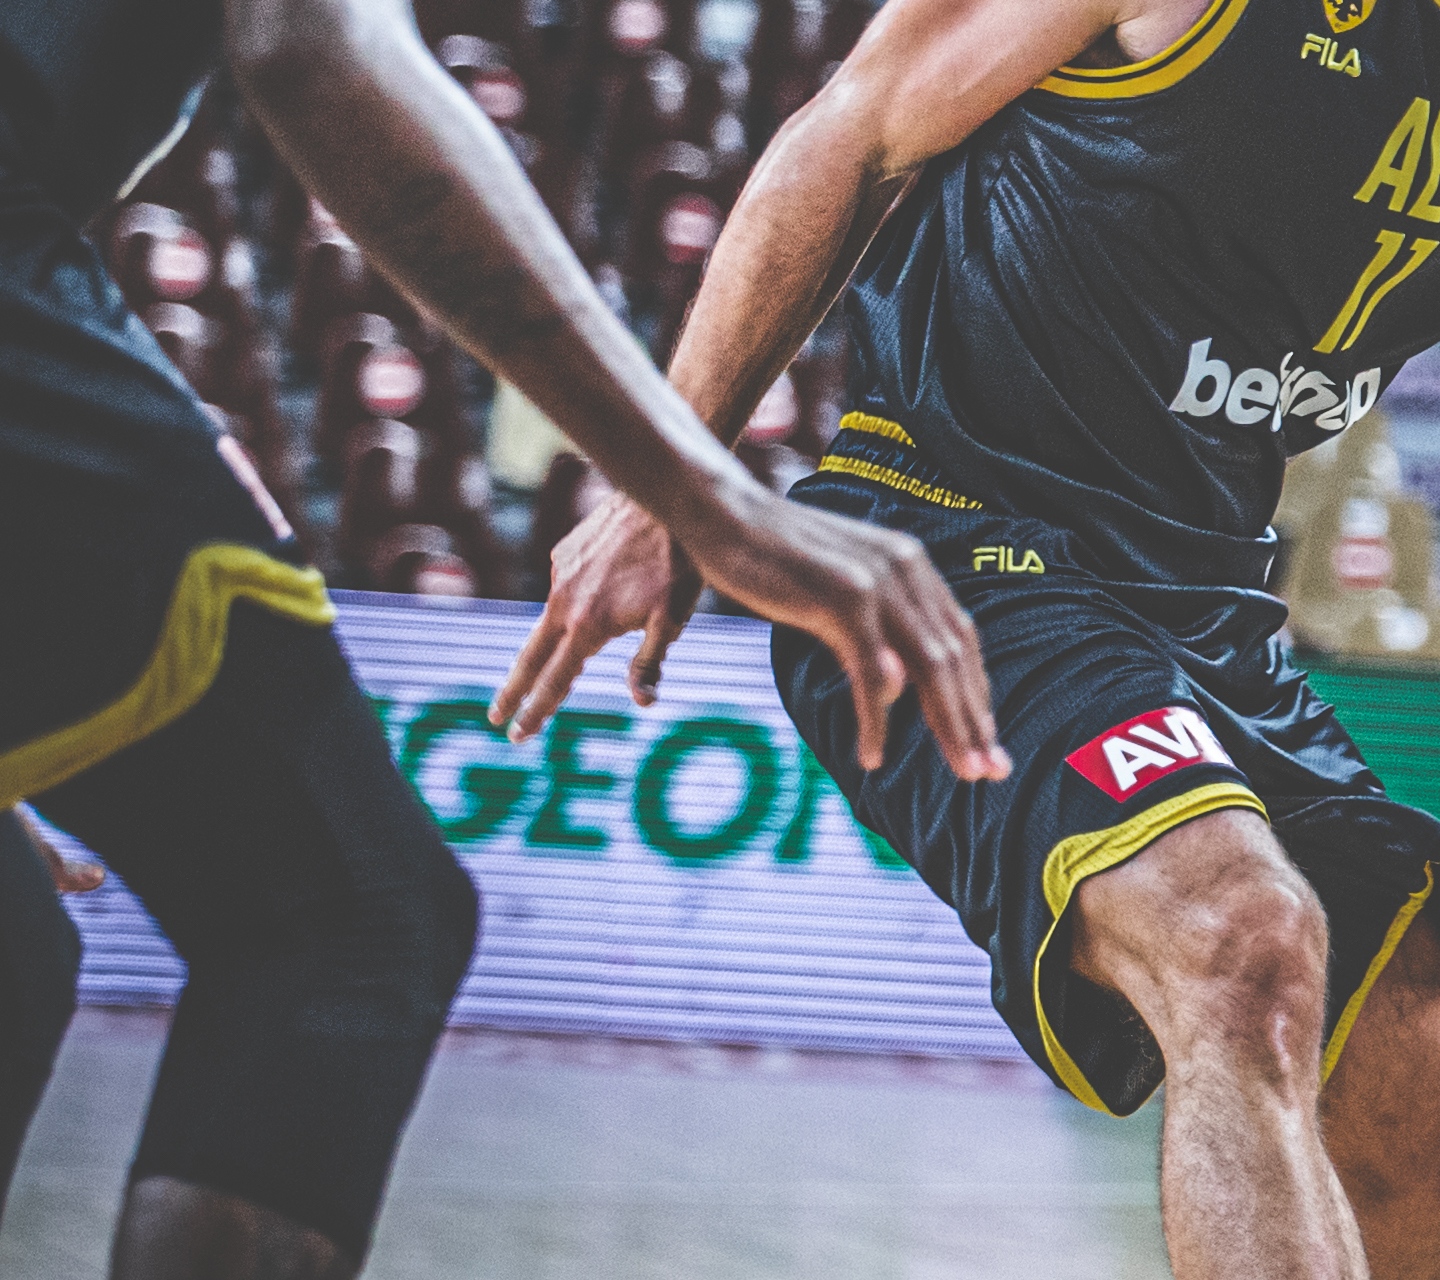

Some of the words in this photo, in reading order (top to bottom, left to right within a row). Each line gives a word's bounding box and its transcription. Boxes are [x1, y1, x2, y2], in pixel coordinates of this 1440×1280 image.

[1301, 33, 1361, 77] FILA
[1312, 229, 1440, 354] 11
[972, 545, 1046, 574] FILA
